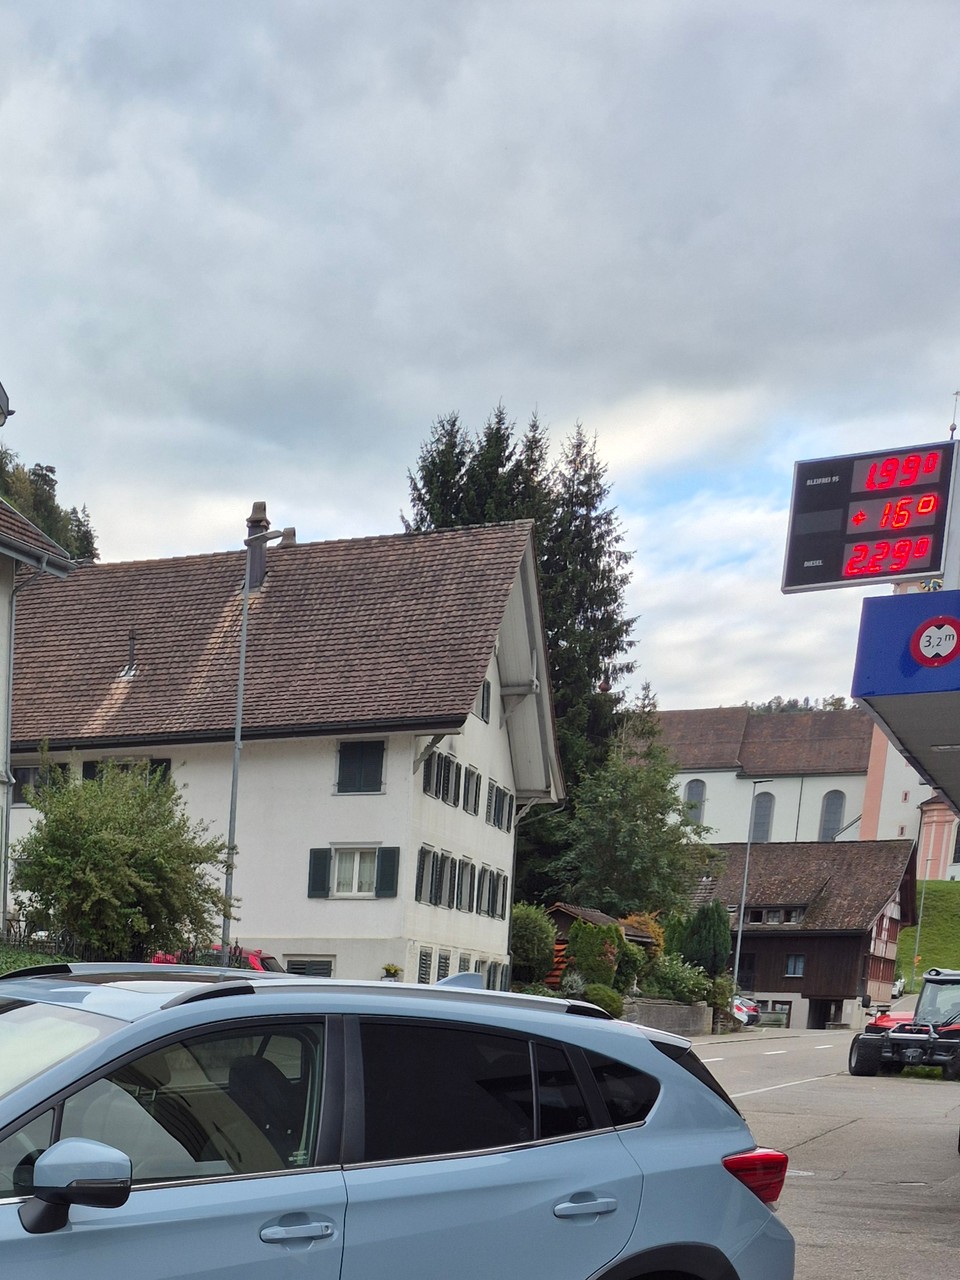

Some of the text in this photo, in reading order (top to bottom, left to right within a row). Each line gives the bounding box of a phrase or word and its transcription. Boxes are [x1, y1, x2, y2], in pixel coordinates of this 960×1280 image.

[806, 475, 840, 486] BLEIFREI 95
[803, 559, 823, 567] DIESEL
